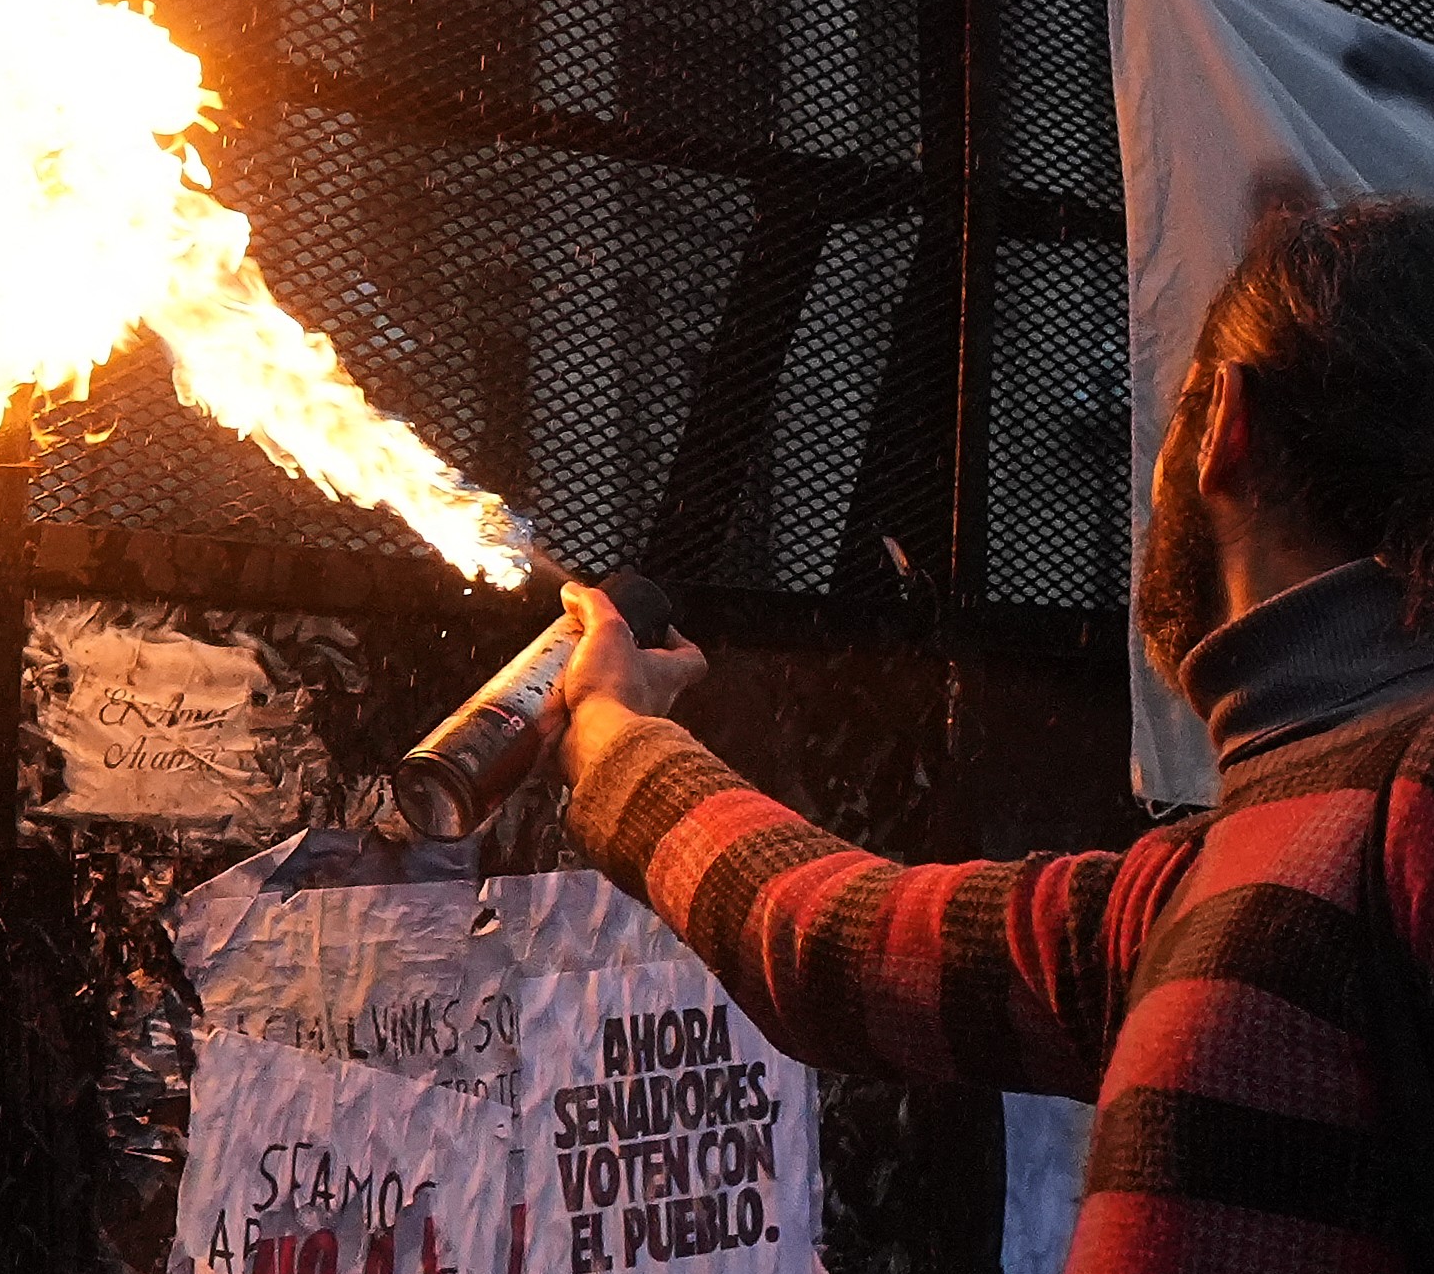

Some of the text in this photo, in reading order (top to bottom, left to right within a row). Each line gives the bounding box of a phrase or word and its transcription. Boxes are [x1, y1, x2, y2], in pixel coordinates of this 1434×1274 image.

[603, 1004, 732, 1078] AHORA
[554, 1061, 781, 1150] SENADORES,
[557, 1124, 777, 1213] VOTEN CON
[623, 1186, 780, 1269] PUEBLO.
